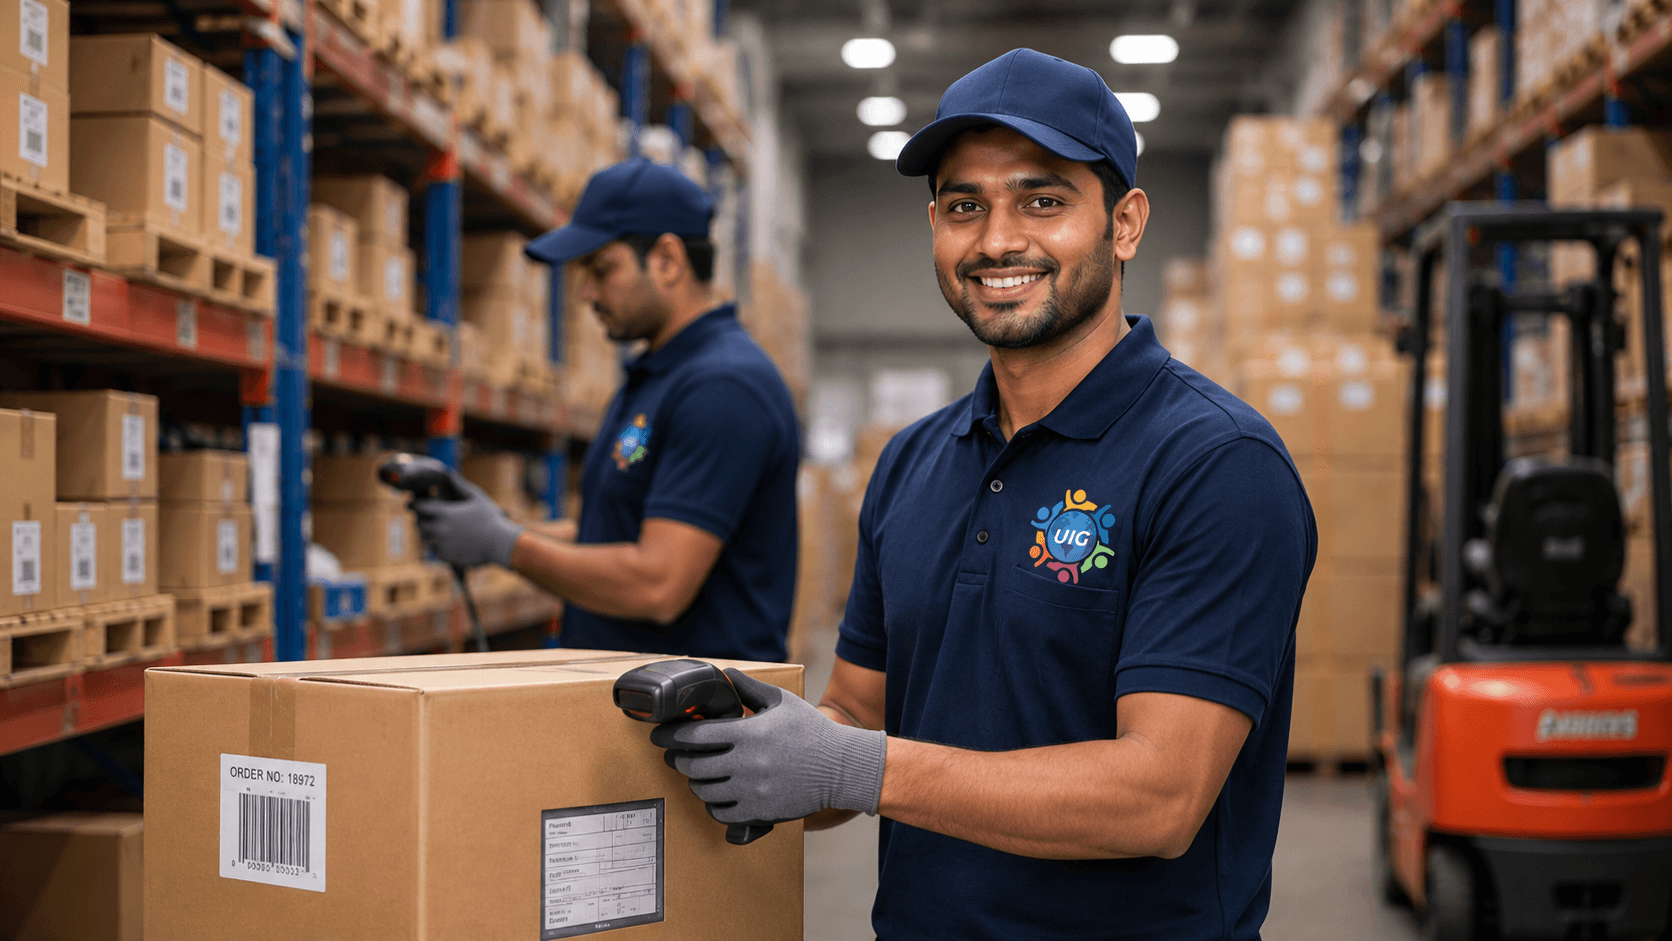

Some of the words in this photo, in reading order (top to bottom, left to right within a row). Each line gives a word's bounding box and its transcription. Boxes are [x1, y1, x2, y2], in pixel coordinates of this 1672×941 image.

[1054, 529, 1091, 547] UIG
[230, 766, 264, 781] ORDER
[266, 770, 284, 783] NO:
[288, 772, 315, 787] 18972
